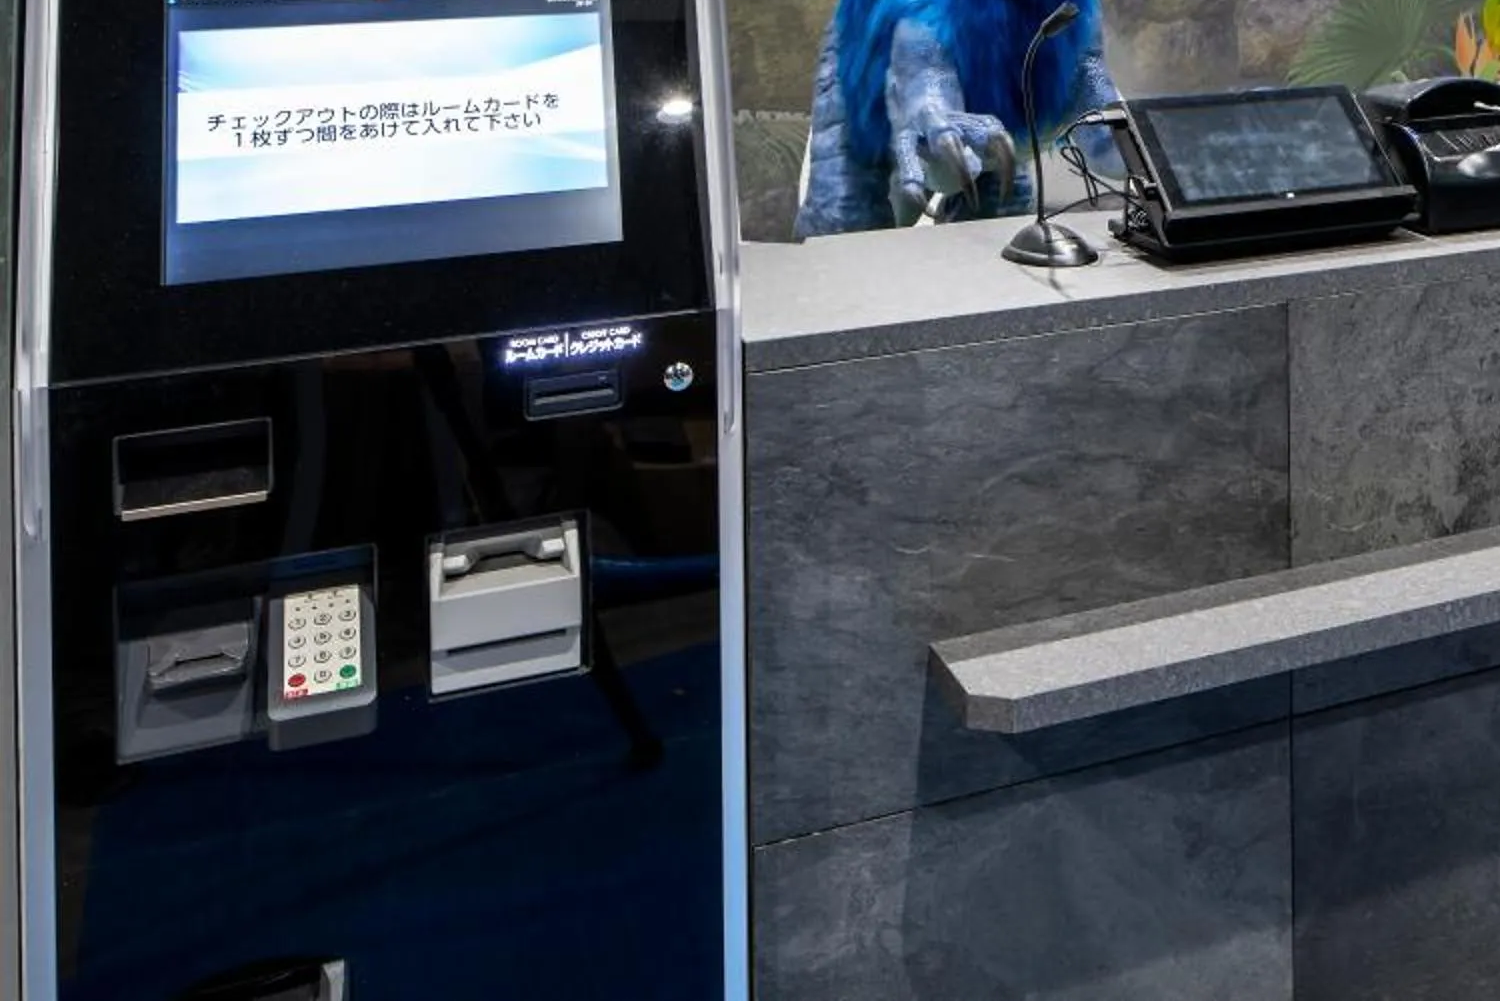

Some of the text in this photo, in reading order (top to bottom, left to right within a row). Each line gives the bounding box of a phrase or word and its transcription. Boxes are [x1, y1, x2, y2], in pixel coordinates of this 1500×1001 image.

[207, 93, 560, 132] チェックアウトの際はルームカードを
